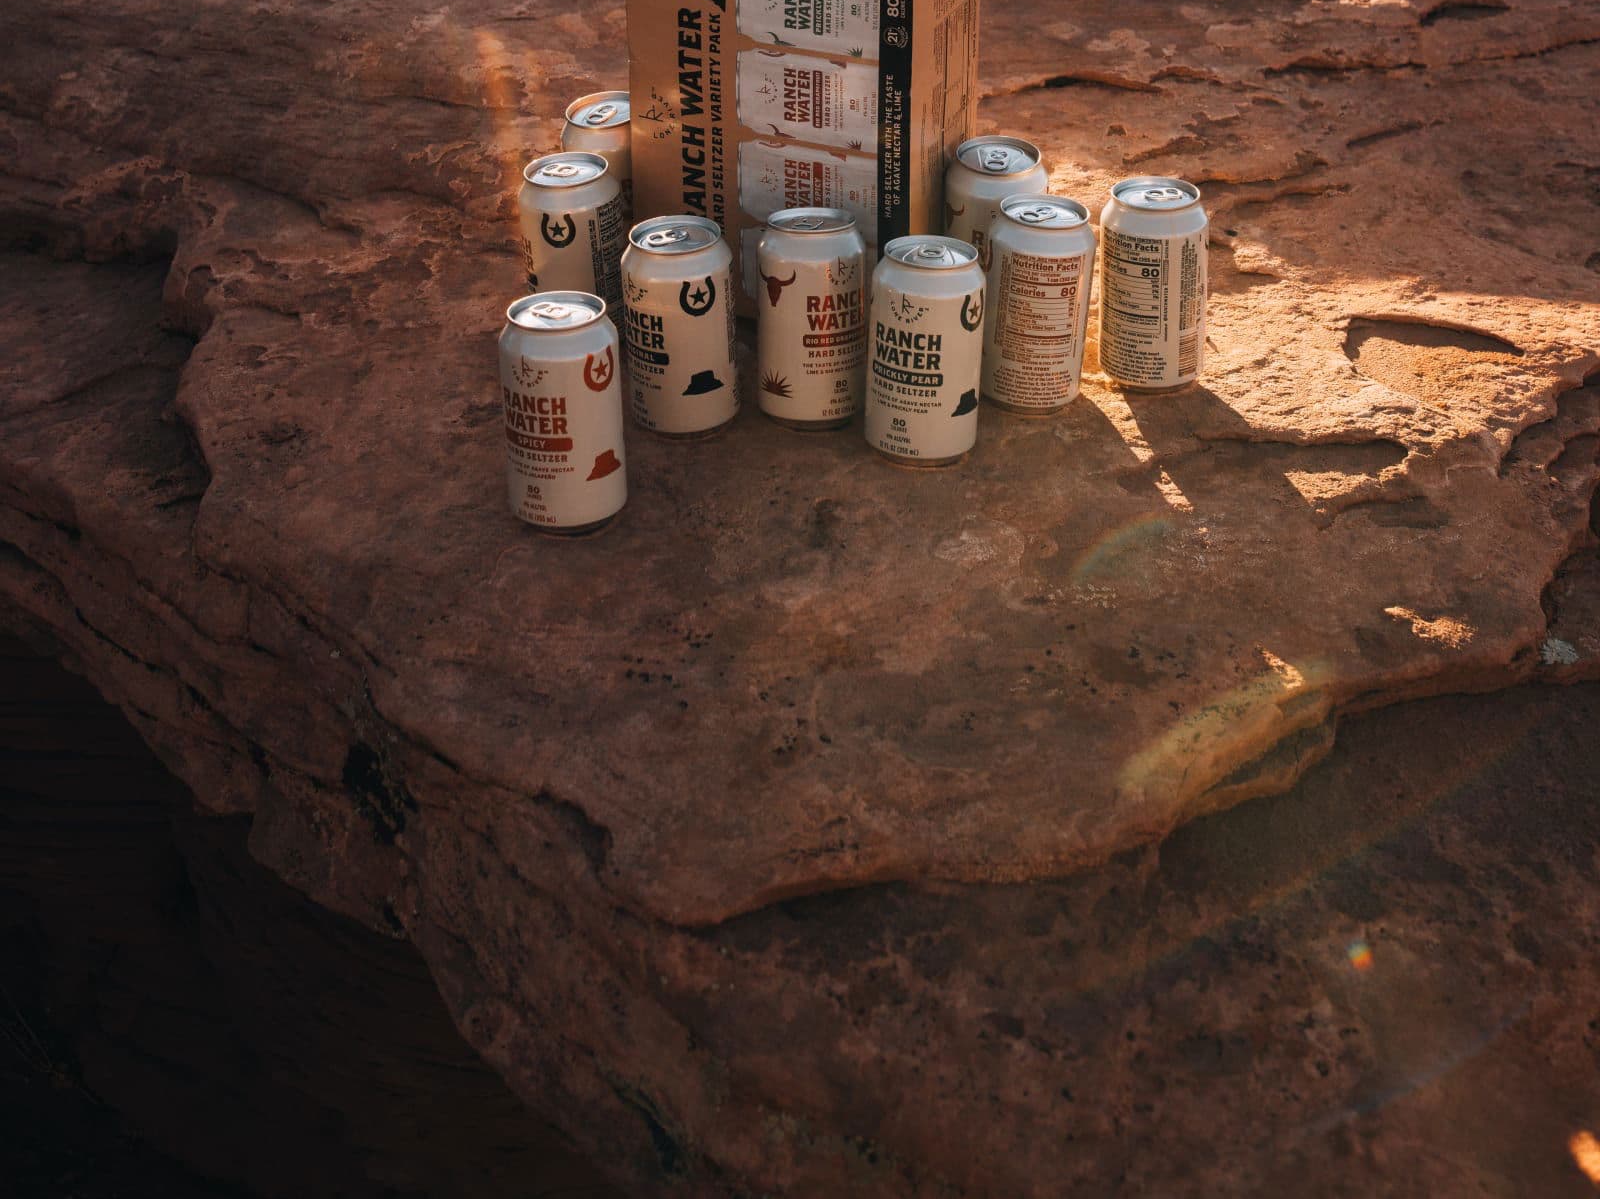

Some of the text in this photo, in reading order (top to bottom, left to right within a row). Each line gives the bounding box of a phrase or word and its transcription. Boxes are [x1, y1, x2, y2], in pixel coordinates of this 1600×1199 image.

[815, 0, 823, 33] PRICKLY
[708, 12, 721, 54] PACK
[709, 60, 723, 122] VARIETY
[783, 67, 797, 122] RANCH
[797, 70, 811, 123] WATER
[894, 90, 902, 112] LIME
[678, 7, 708, 219] ANCH WATER
[884, 74, 894, 218] HARD SELTZER WITH THE TASTE
[893, 126, 901, 160] NECTAR
[711, 126, 725, 189] SELTZER
[784, 159, 797, 209] RANCH
[893, 162, 901, 193] AGAVE
[893, 194, 900, 205] OF
[1134, 243, 1160, 252] Facts
[1013, 258, 1053, 271] Nutrition
[1057, 263, 1079, 271] Facts
[1141, 267, 1160, 278] 80
[806, 288, 865, 313] RANCH
[1010, 284, 1076, 298] Calories 80
[624, 304, 664, 332] ANCH
[806, 309, 865, 331] WATER
[626, 327, 665, 350] ATER
[805, 337, 819, 345] RIO
[820, 336, 834, 344] RED
[876, 320, 942, 352] RANCH
[808, 343, 865, 358] HARD SELTZE
[875, 339, 941, 370] WATER
[634, 359, 665, 376] LTZER
[874, 363, 939, 385] PRICKLY PEAR
[835, 379, 848, 388] 80
[874, 377, 937, 398] HARD SELTZER
[503, 387, 567, 416] RANCH
[505, 407, 568, 435] WATER
[892, 417, 906, 428] 80
[517, 435, 547, 449] SPICY
[527, 450, 568, 463] SELTZER
[527, 484, 540, 494] 80
